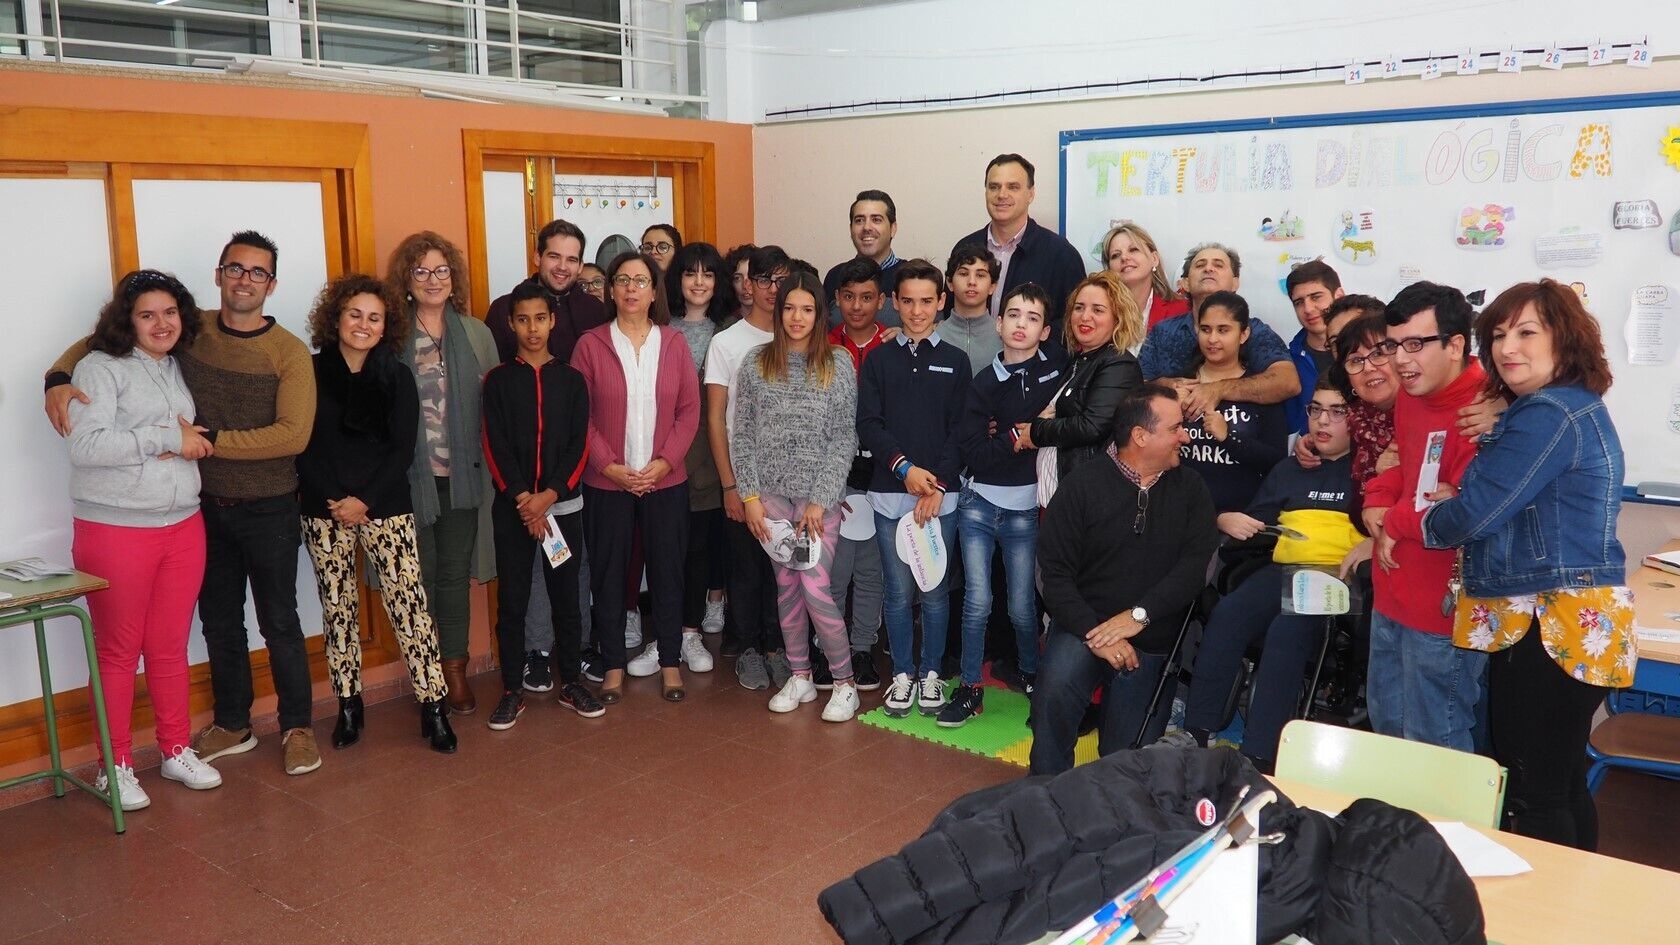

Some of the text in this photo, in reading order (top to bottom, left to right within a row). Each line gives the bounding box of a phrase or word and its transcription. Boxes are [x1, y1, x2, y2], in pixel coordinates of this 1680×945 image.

[1546, 53, 1560, 63] 26
[1593, 49, 1605, 60] 27
[1633, 50, 1648, 61] 28
[1462, 59, 1473, 69] 24
[1504, 56, 1516, 67] 25
[1385, 62, 1397, 72] 22
[1349, 70, 1360, 80] 21
